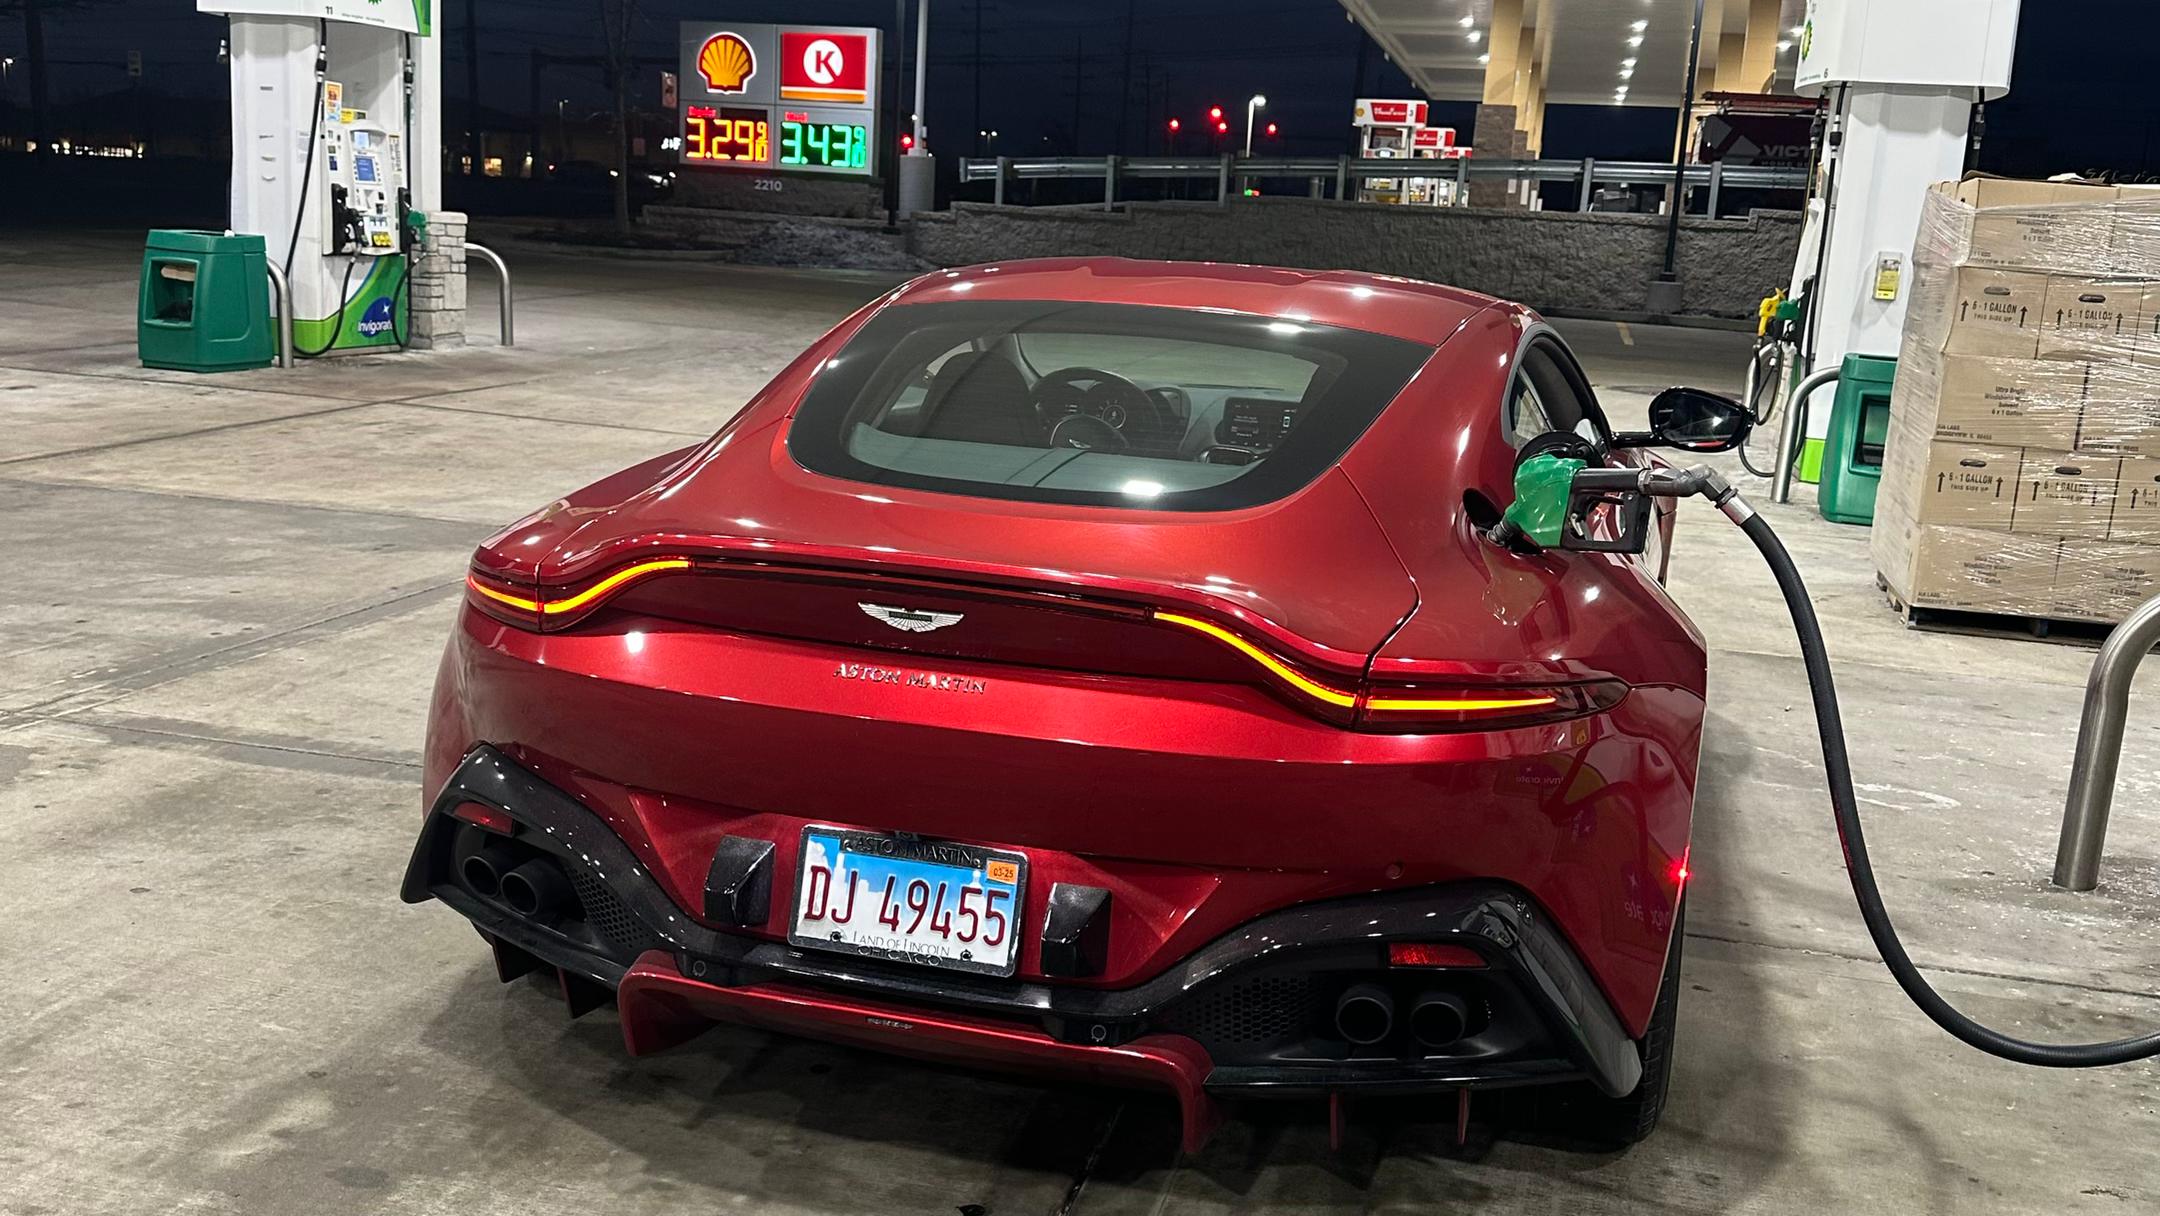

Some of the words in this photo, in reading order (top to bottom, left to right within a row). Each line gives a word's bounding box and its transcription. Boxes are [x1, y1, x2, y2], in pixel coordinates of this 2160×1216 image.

[326, 6, 333, 15] 11
[815, 50, 838, 76] K
[686, 117, 754, 160] 3.29
[781, 122, 852, 167] 3.43
[754, 180, 782, 191] 2210
[1989, 302, 2017, 314] GALLON
[358, 320, 392, 335] Invigorat
[1965, 473, 1993, 484] GALLON
[833, 663, 901, 685] ASTON
[906, 672, 987, 695] MARTIN
[856, 837, 909, 856] ASTON
[912, 844, 973, 862] MARTIN
[993, 867, 1014, 878] 03-25
[804, 865, 858, 924] DJ
[879, 875, 1011, 946] 49455
[853, 931, 884, 946] LAND
[904, 938, 950, 956] LINCOLN
